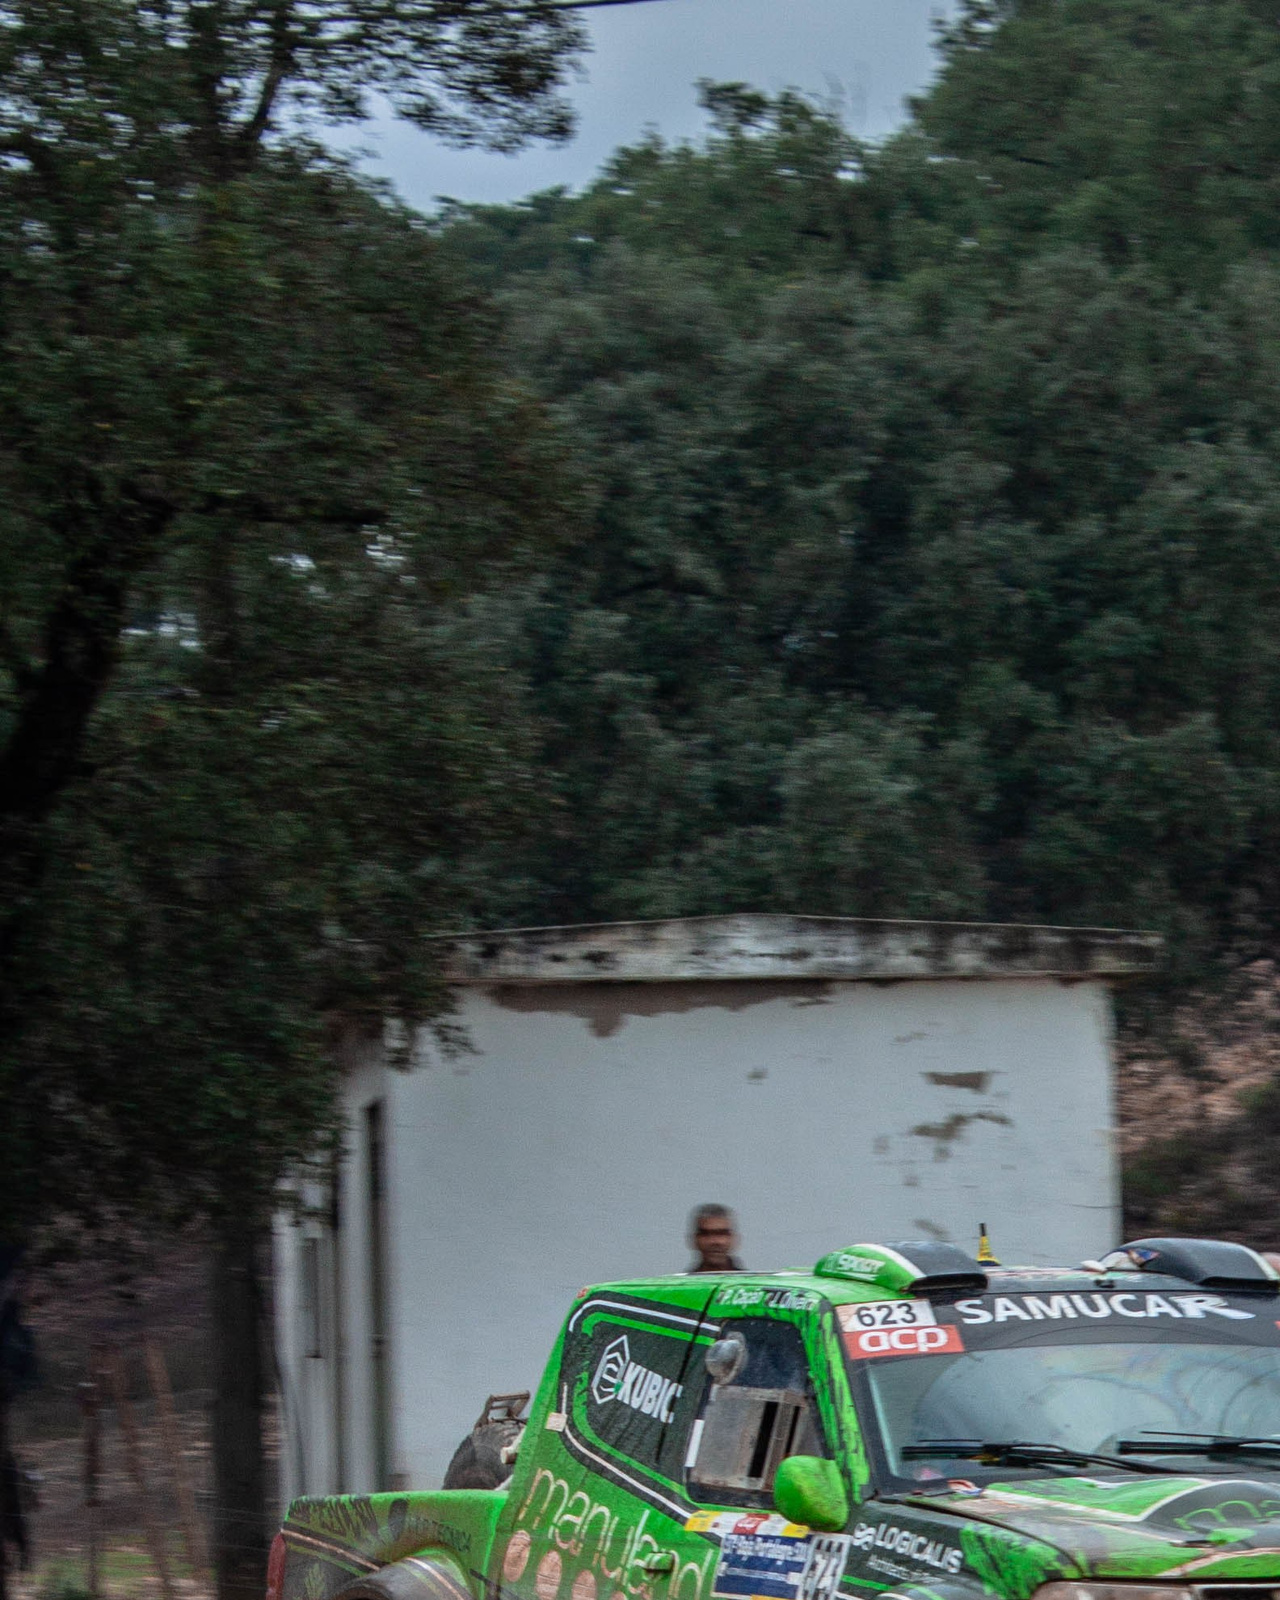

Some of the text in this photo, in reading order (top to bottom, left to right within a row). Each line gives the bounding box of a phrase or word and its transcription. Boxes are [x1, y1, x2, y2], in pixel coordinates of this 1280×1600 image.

[856, 1302, 917, 1327] 623
[954, 1293, 1256, 1325] SAMUCAR
[858, 1327, 948, 1352] acp
[617, 1361, 684, 1424] KUBIC
[874, 1522, 964, 1574] LOGICALIS
